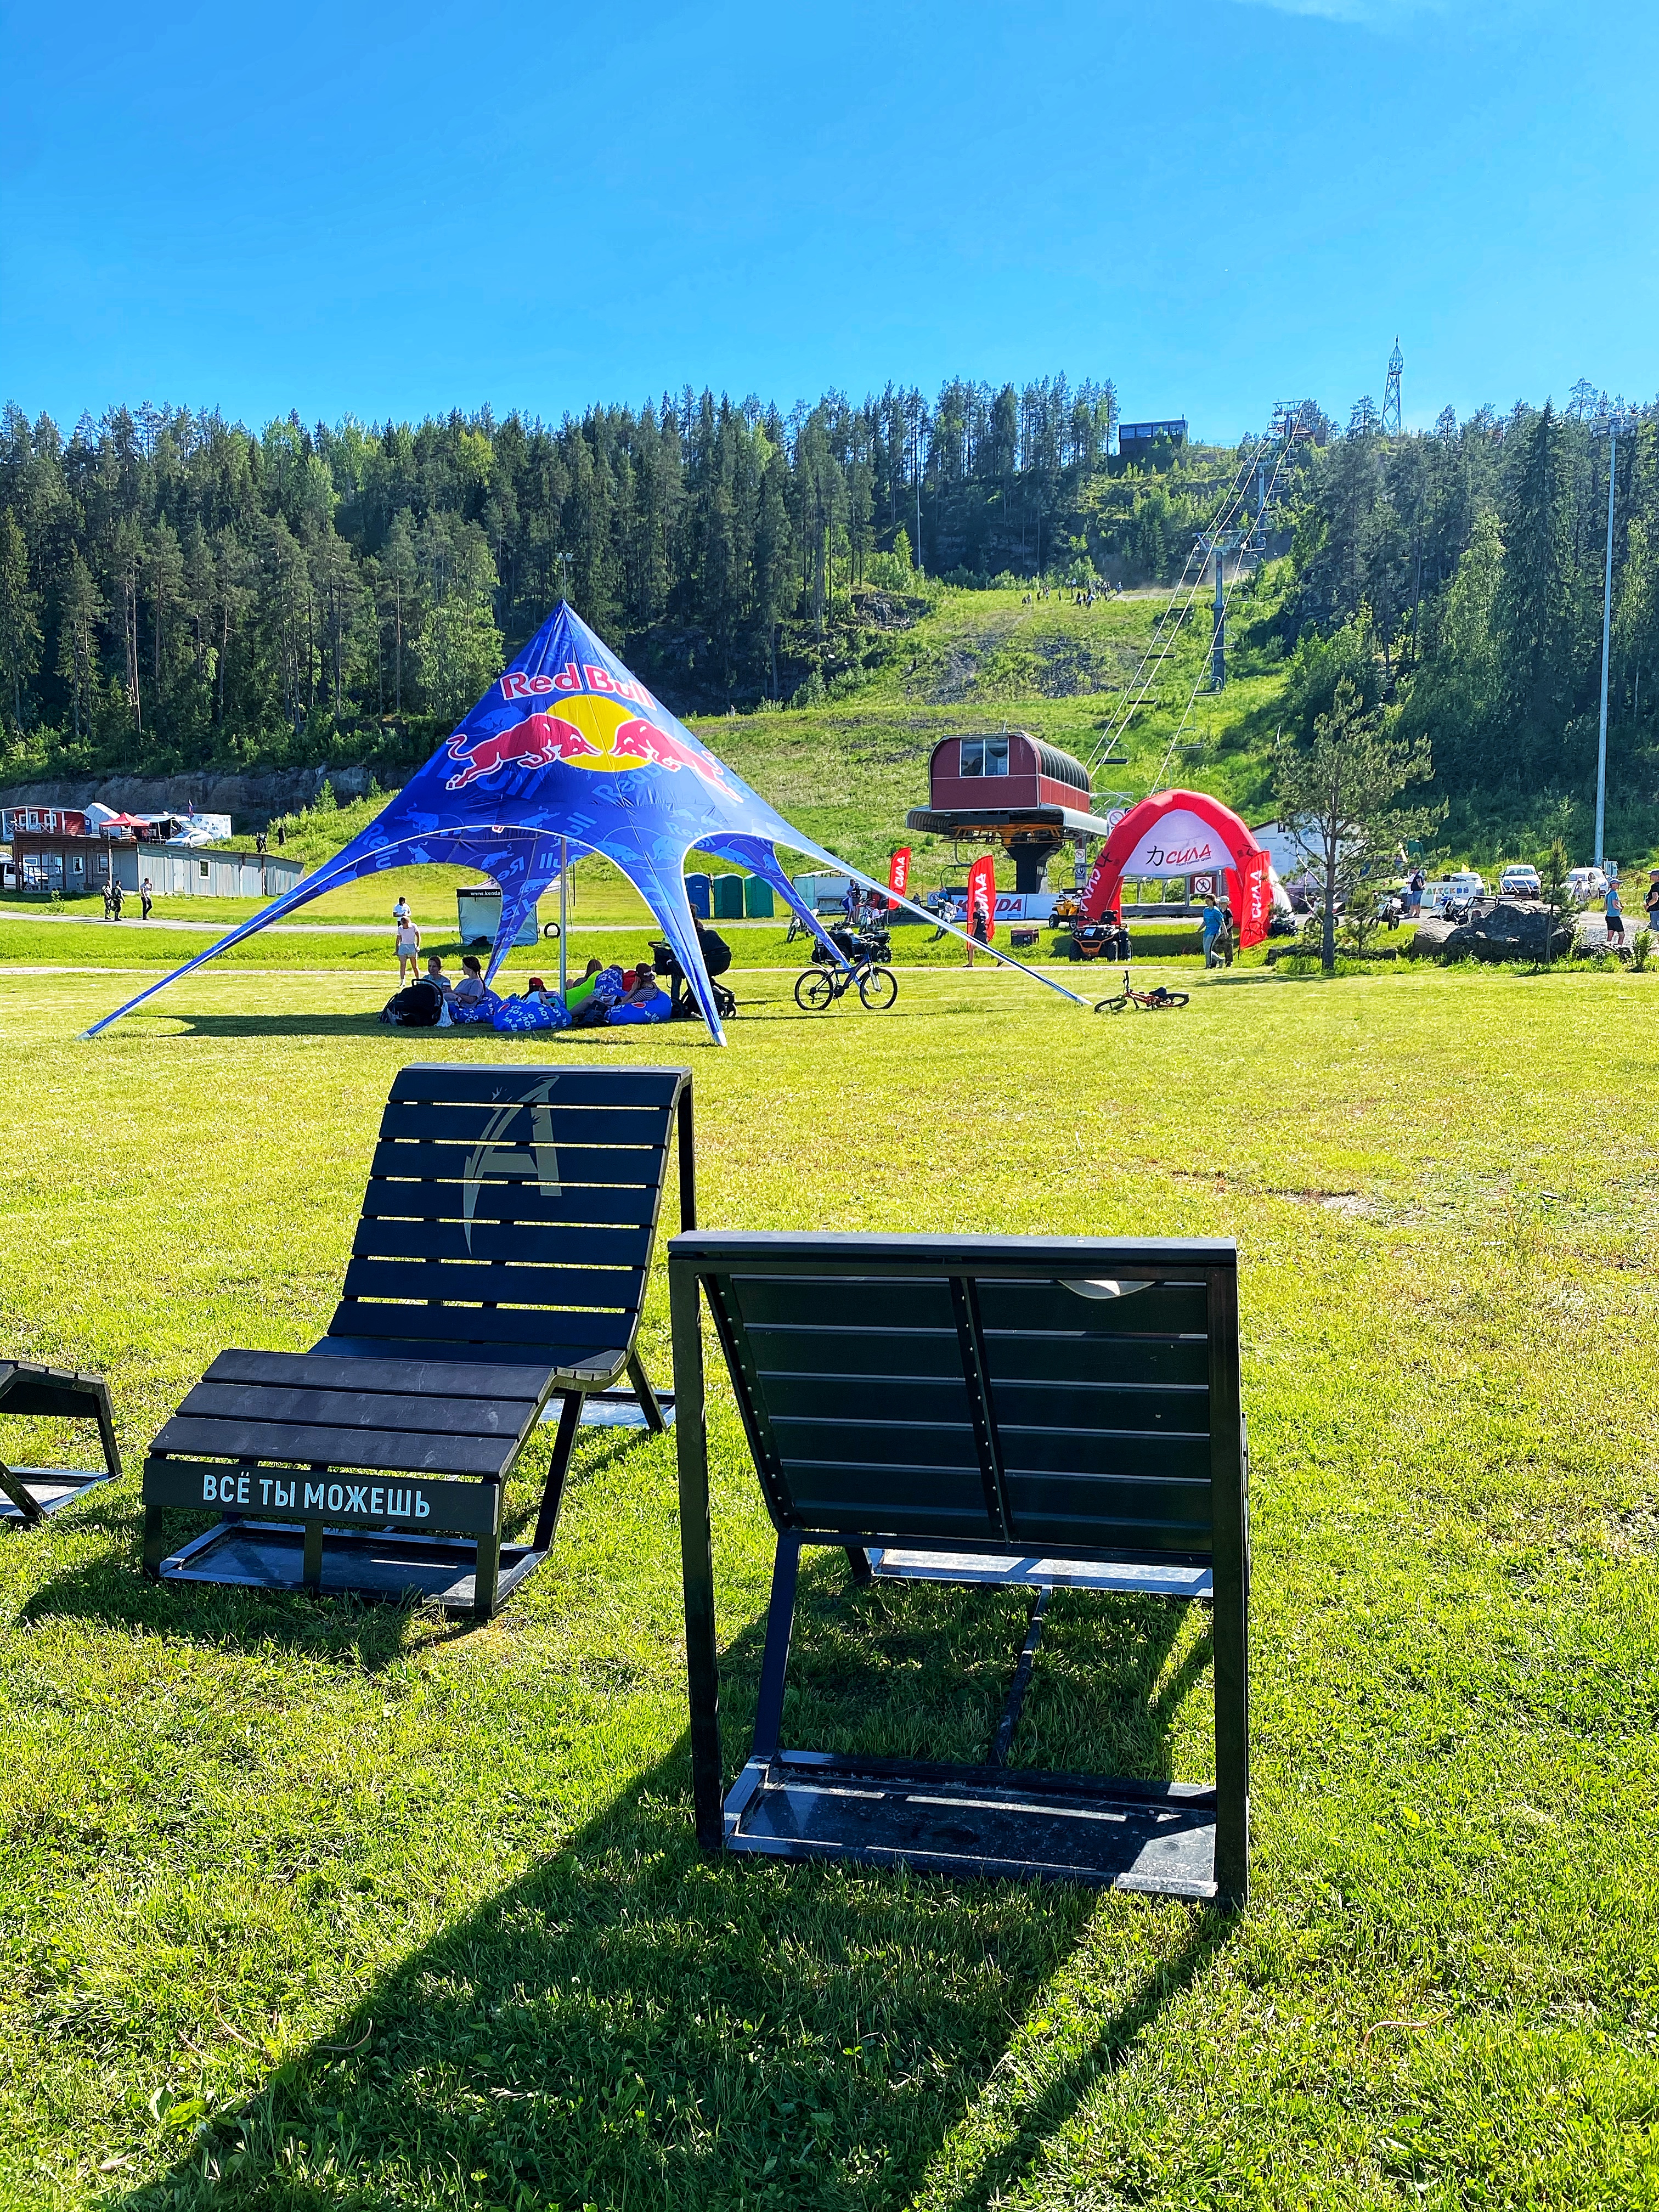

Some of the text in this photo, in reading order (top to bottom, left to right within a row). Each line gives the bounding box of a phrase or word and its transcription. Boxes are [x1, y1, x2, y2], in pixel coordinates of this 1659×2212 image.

[500, 662, 658, 711] Red Bull
[894, 856, 906, 887] СИЛА
[1166, 844, 1212, 864] СИЛА
[203, 1472, 431, 1517] ВСЁ ТЫ МОЖЕШЬ
